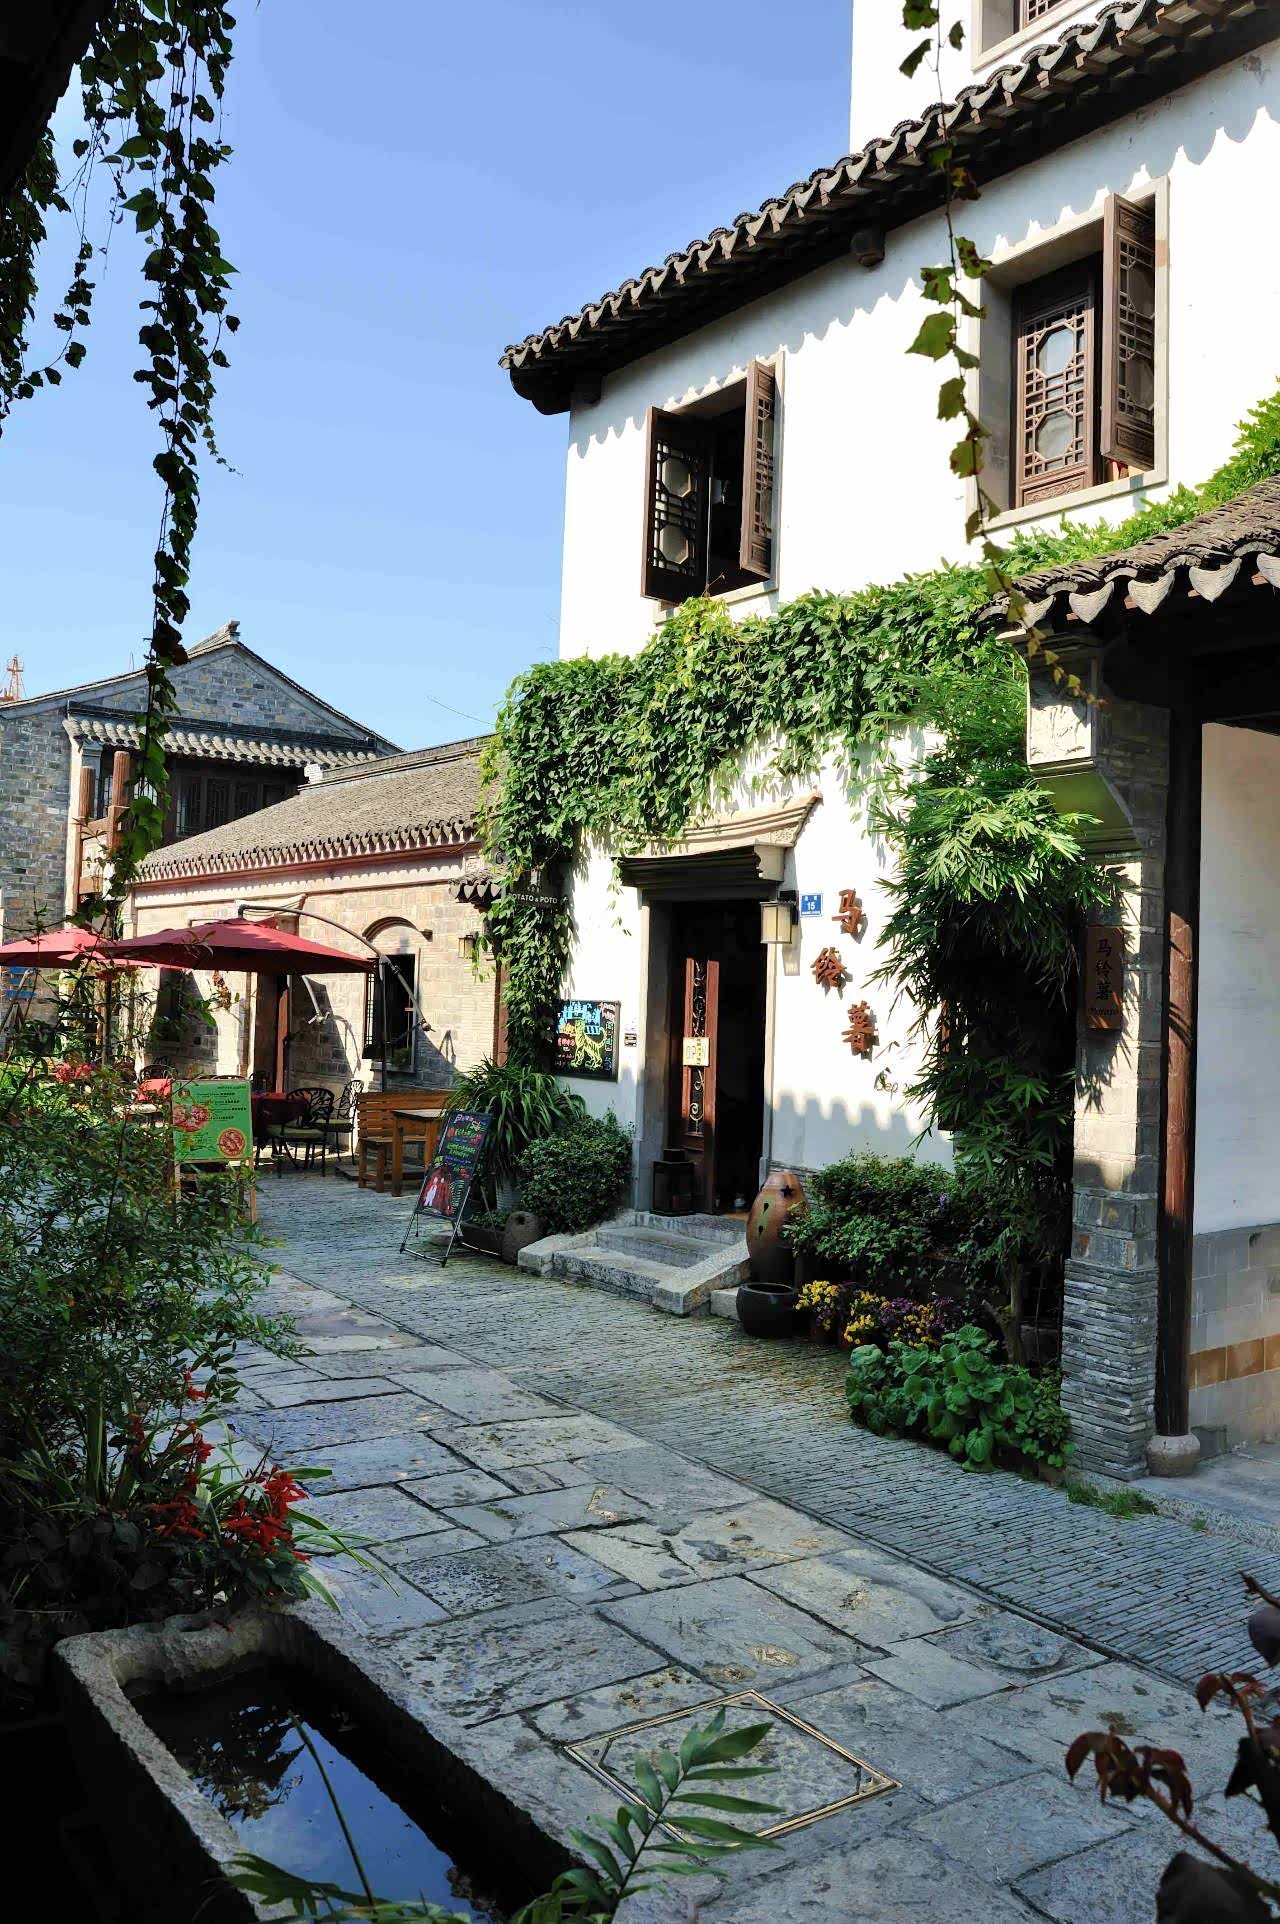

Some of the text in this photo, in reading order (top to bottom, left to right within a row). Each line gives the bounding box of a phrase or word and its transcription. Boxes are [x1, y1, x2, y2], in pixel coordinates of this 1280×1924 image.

[508, 893, 534, 902] OTATO
[807, 902, 816, 910] 15
[810, 888, 877, 1056] 马铃薯
